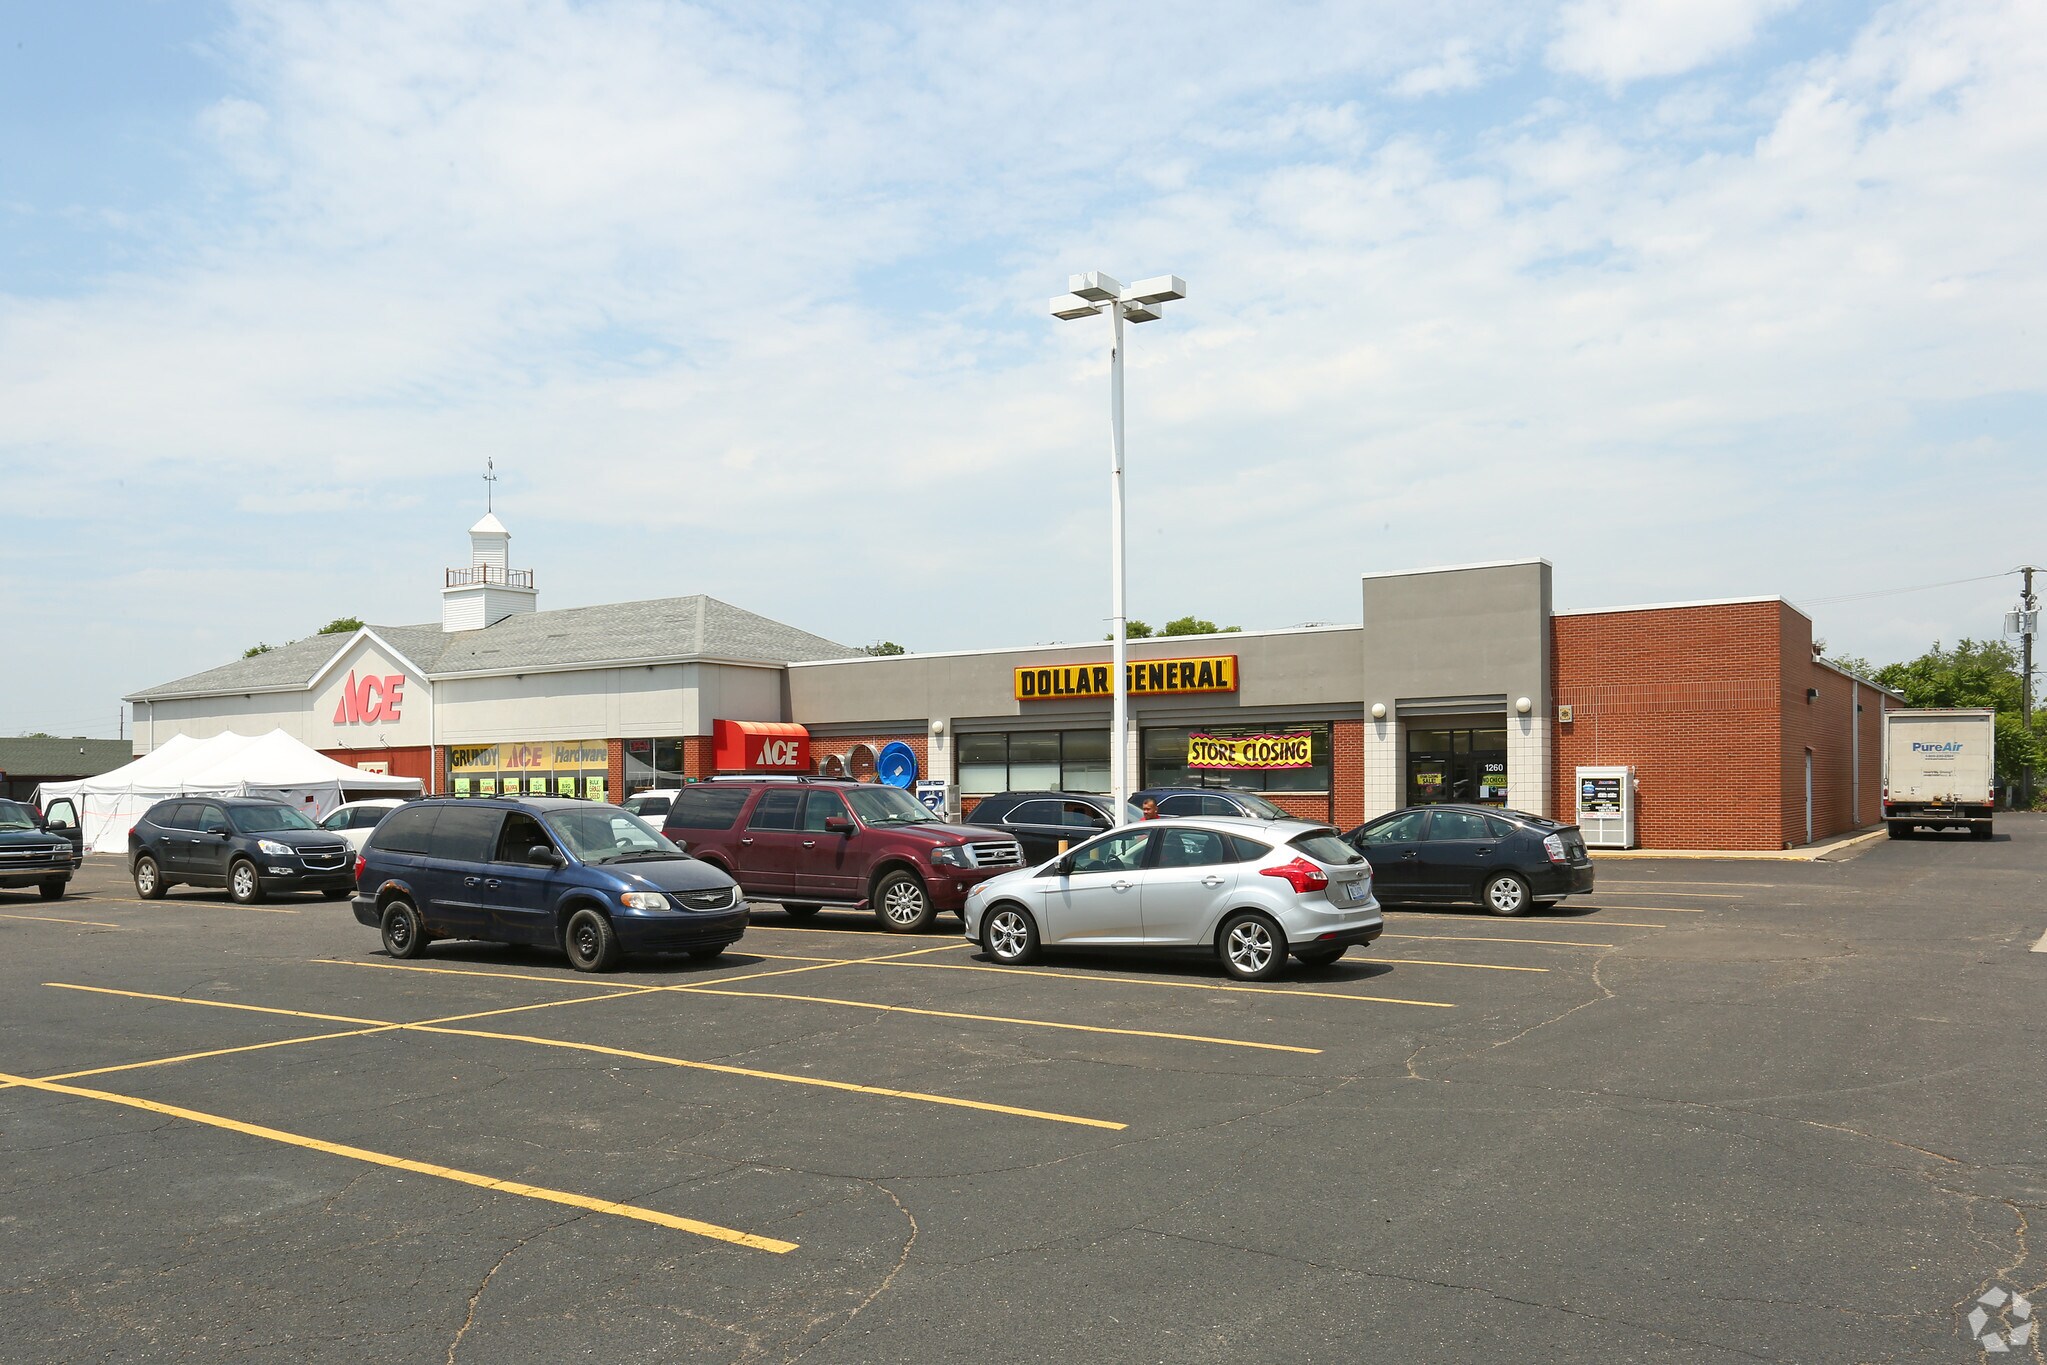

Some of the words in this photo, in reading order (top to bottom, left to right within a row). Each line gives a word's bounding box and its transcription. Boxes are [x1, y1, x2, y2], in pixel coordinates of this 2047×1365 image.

[1021, 667, 1108, 696] DOLLAR
[332, 669, 406, 725] ACE
[452, 748, 497, 767] GRUNDY
[506, 745, 543, 768] ACE
[555, 746, 607, 763] Hardware
[756, 737, 799, 766] ACE
[1192, 742, 1236, 762] STORE
[1243, 741, 1308, 762] CLOSING
[1912, 741, 1963, 752] PureAir
[1484, 764, 1504, 772] 1260
